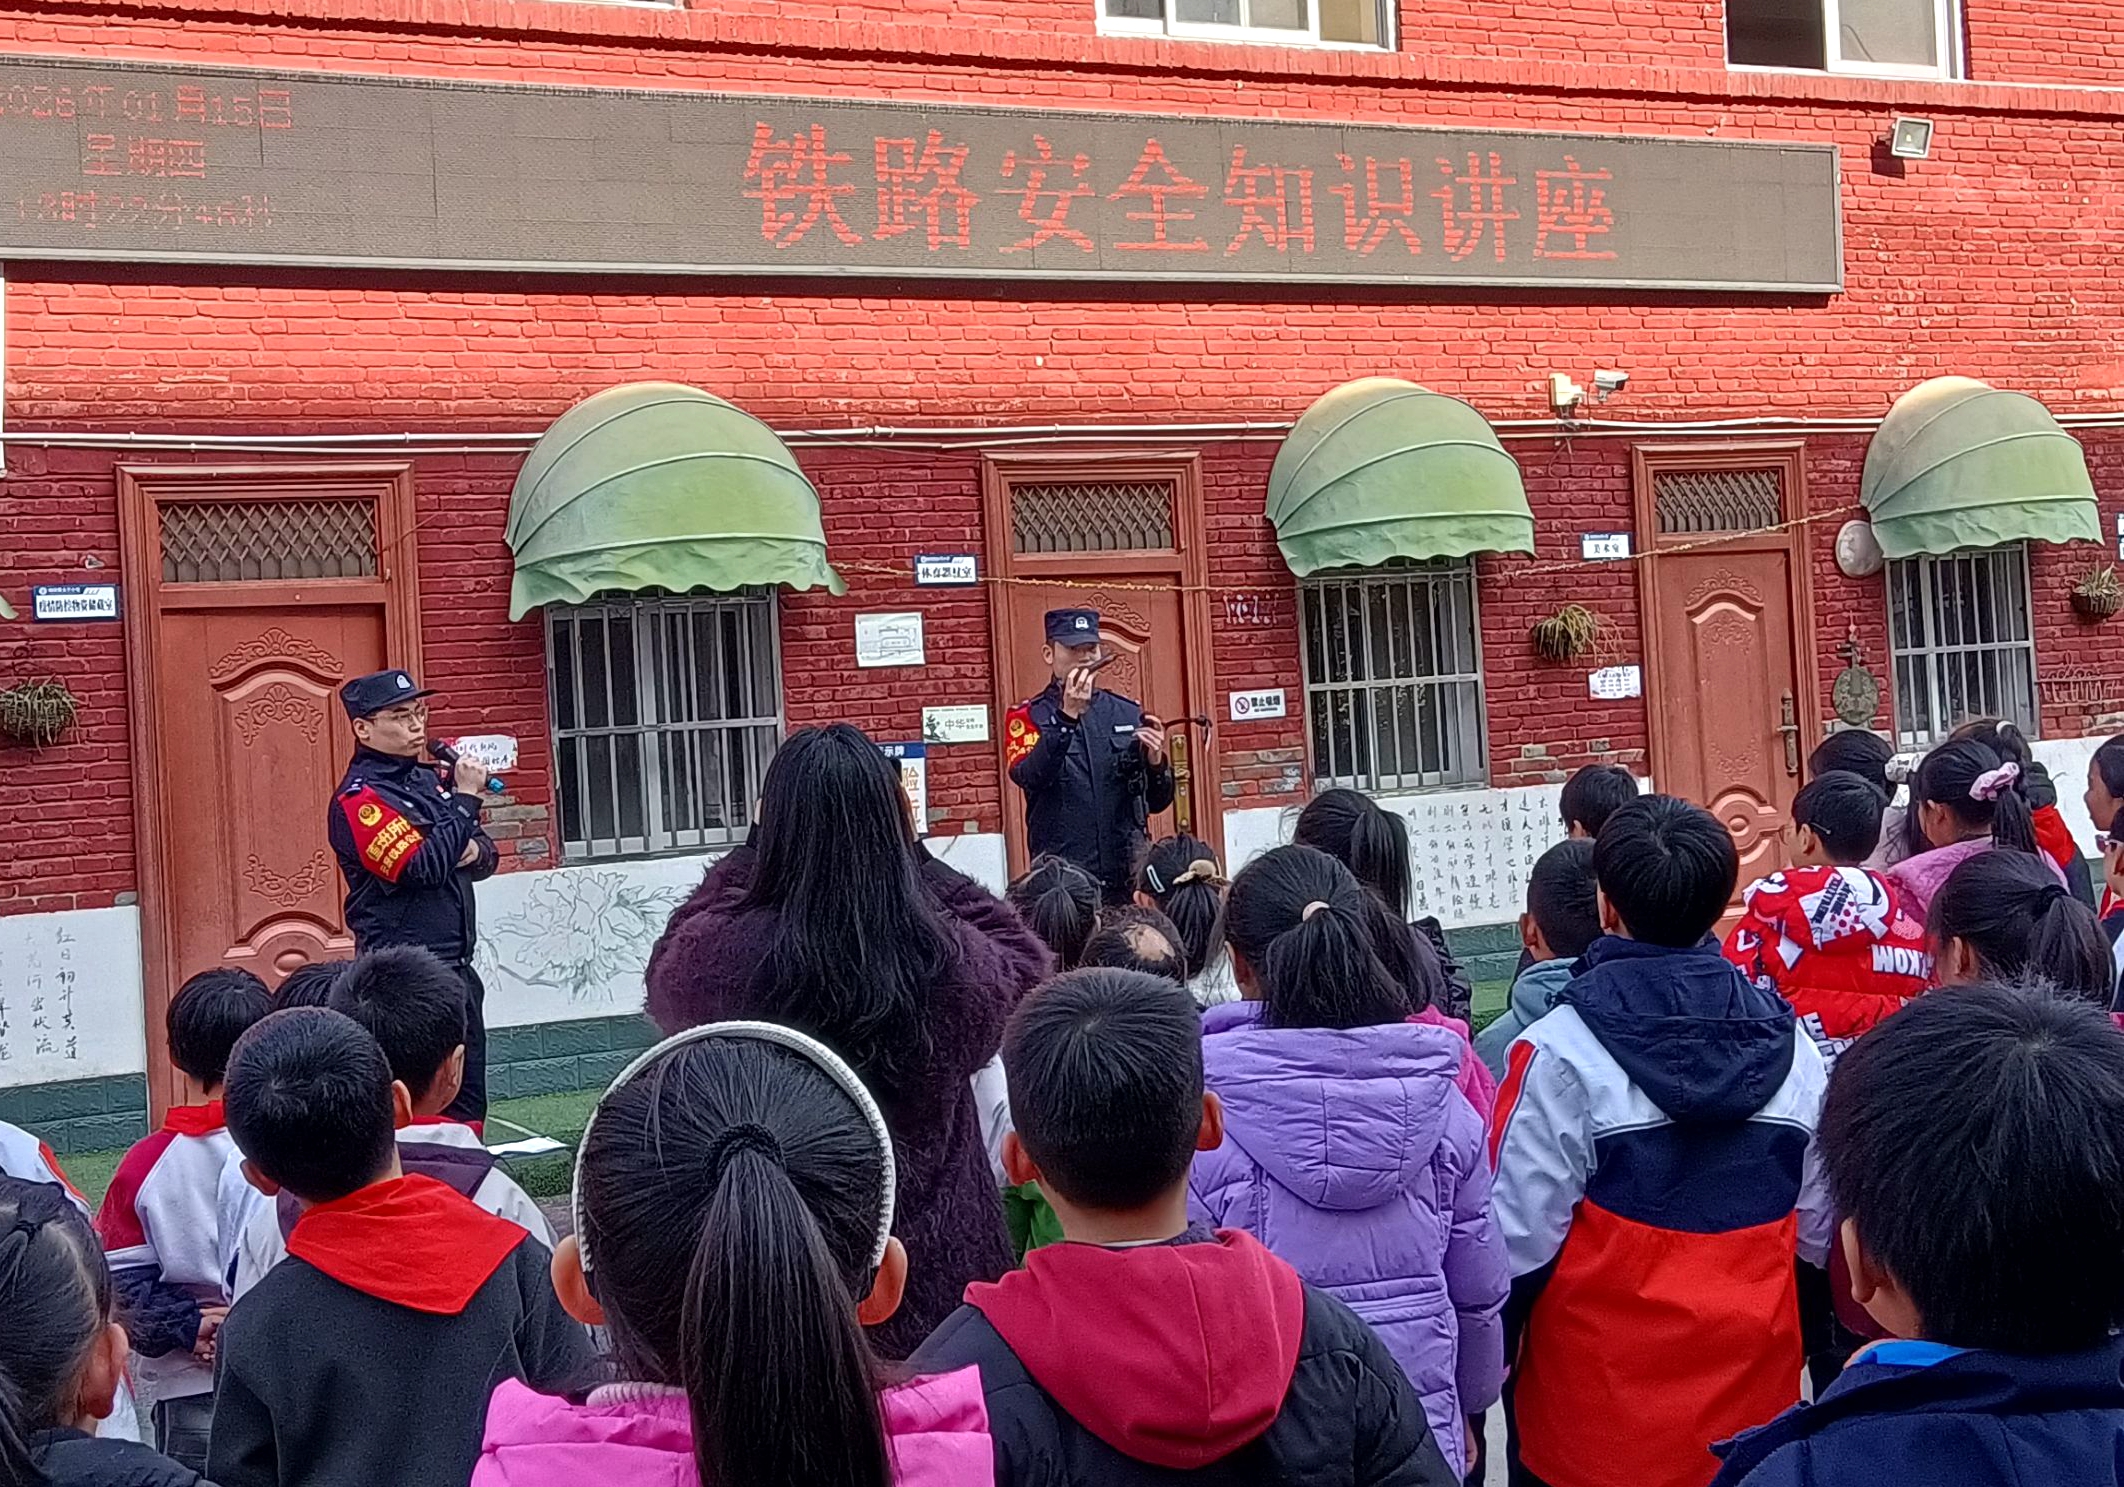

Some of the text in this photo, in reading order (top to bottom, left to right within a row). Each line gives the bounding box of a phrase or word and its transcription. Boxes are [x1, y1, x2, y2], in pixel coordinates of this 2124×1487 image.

[742, 119, 1618, 263] 铁路安全知识讲座
[878, 744, 906, 758] 示牌
